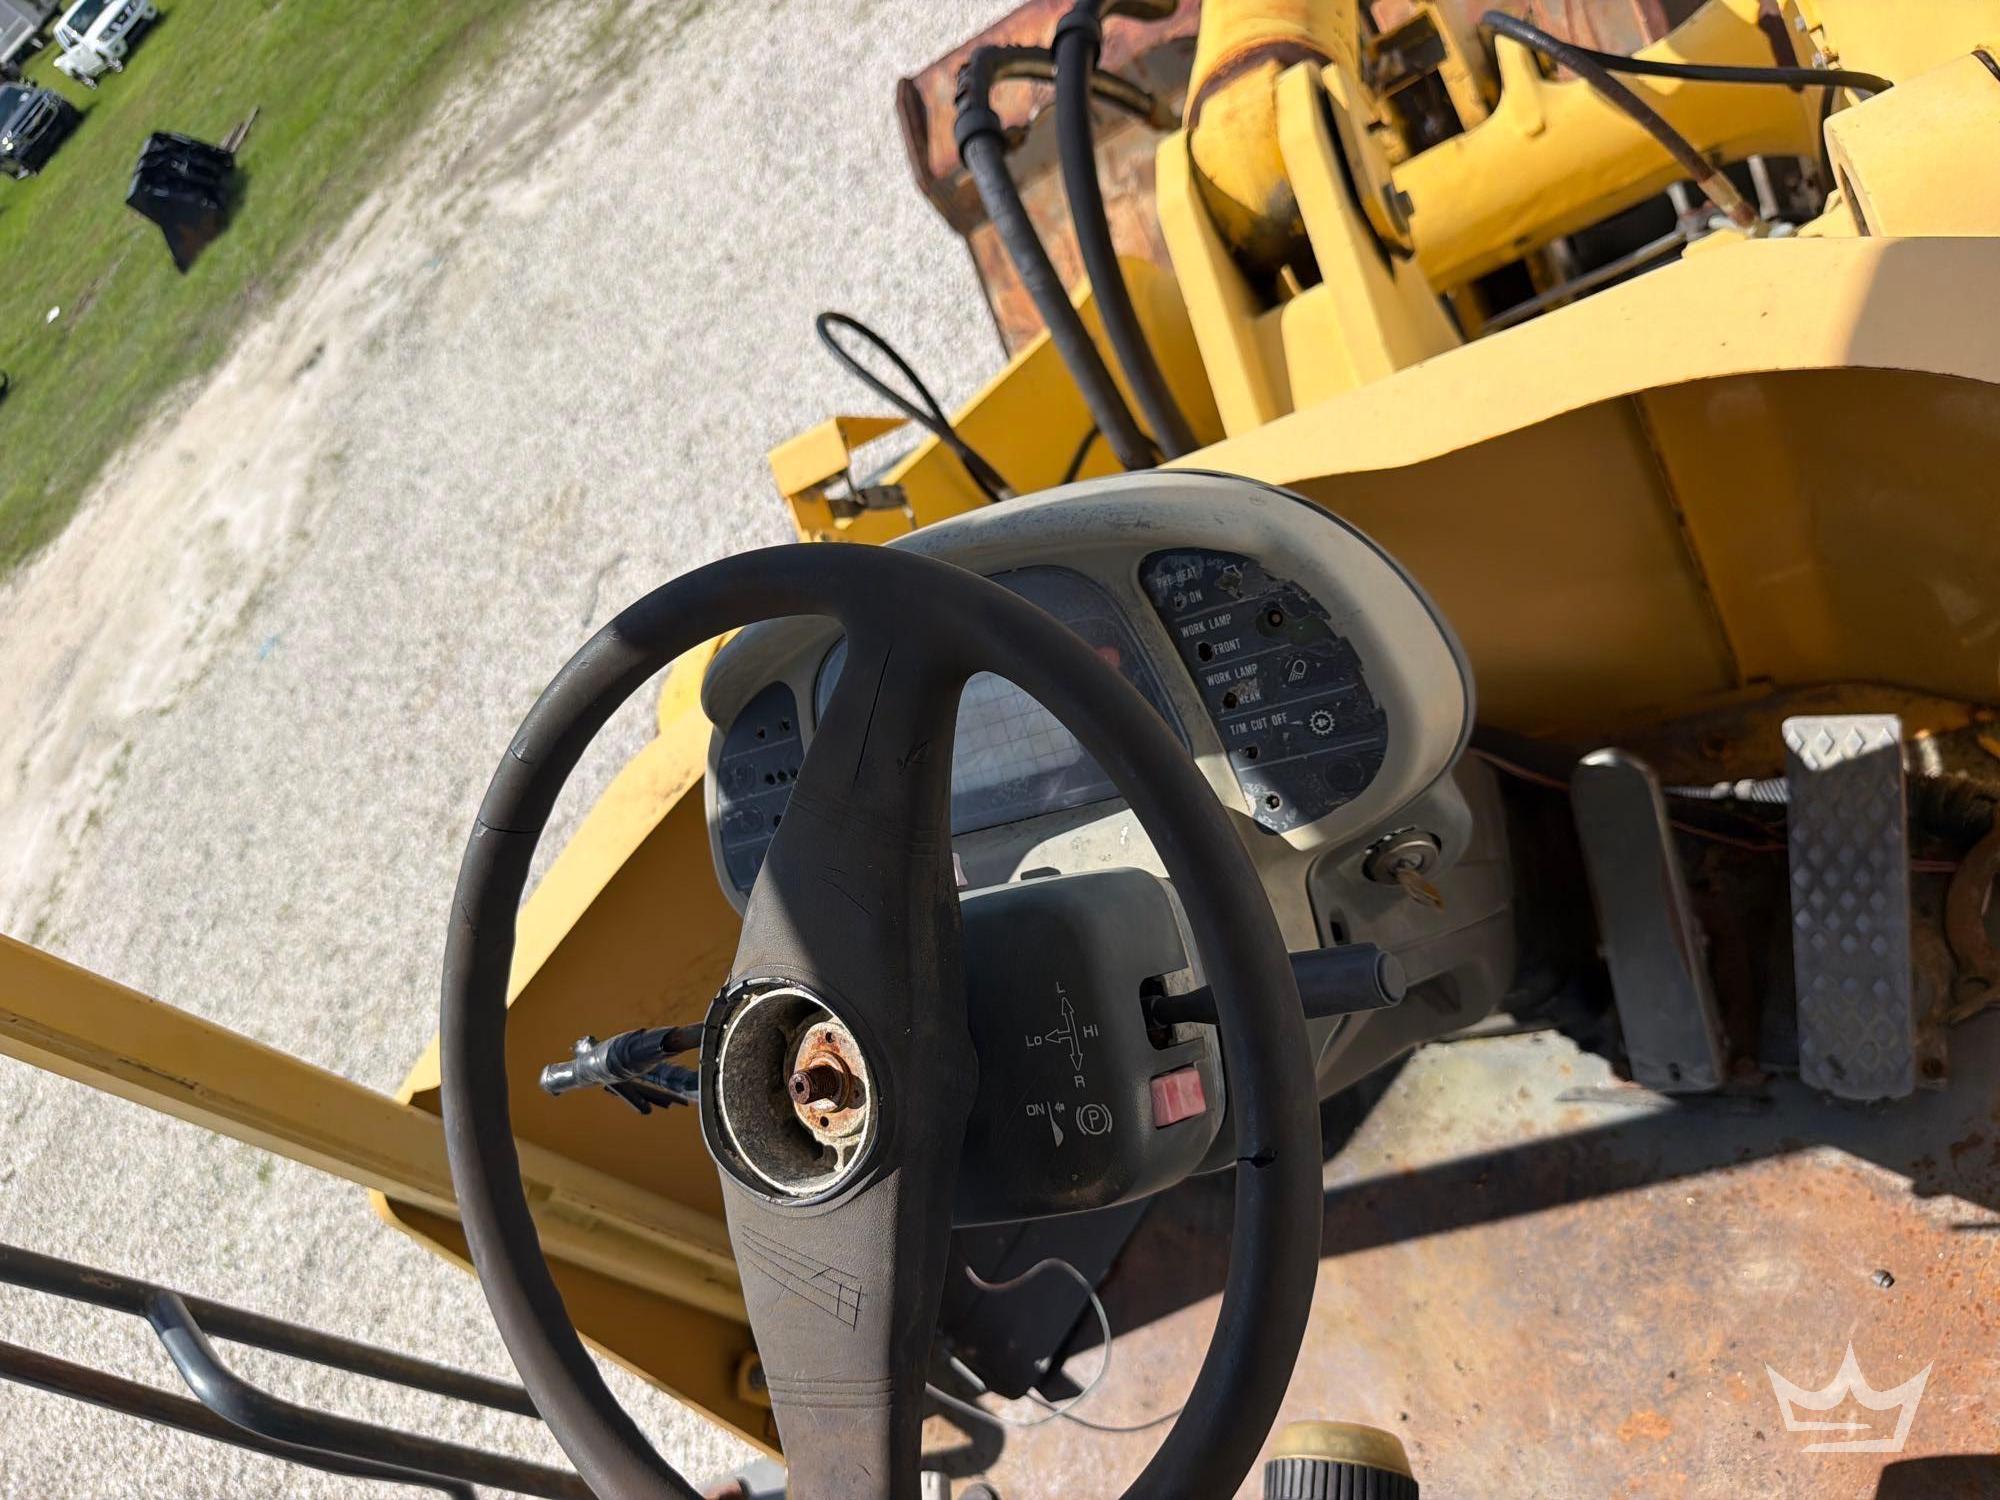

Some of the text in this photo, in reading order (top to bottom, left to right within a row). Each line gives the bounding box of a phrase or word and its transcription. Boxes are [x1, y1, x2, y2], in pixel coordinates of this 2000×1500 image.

[1189, 590, 1203, 603] ON
[1181, 613, 1231, 638] WORK LAMP
[1213, 638, 1241, 655] FRONT
[1206, 663, 1258, 687] WORK LAMP
[1230, 712, 1288, 736] T/M CUT OFF
[1056, 982, 1065, 994] L
[1074, 1075, 1086, 1088] R
[1026, 1103, 1045, 1116] ON
